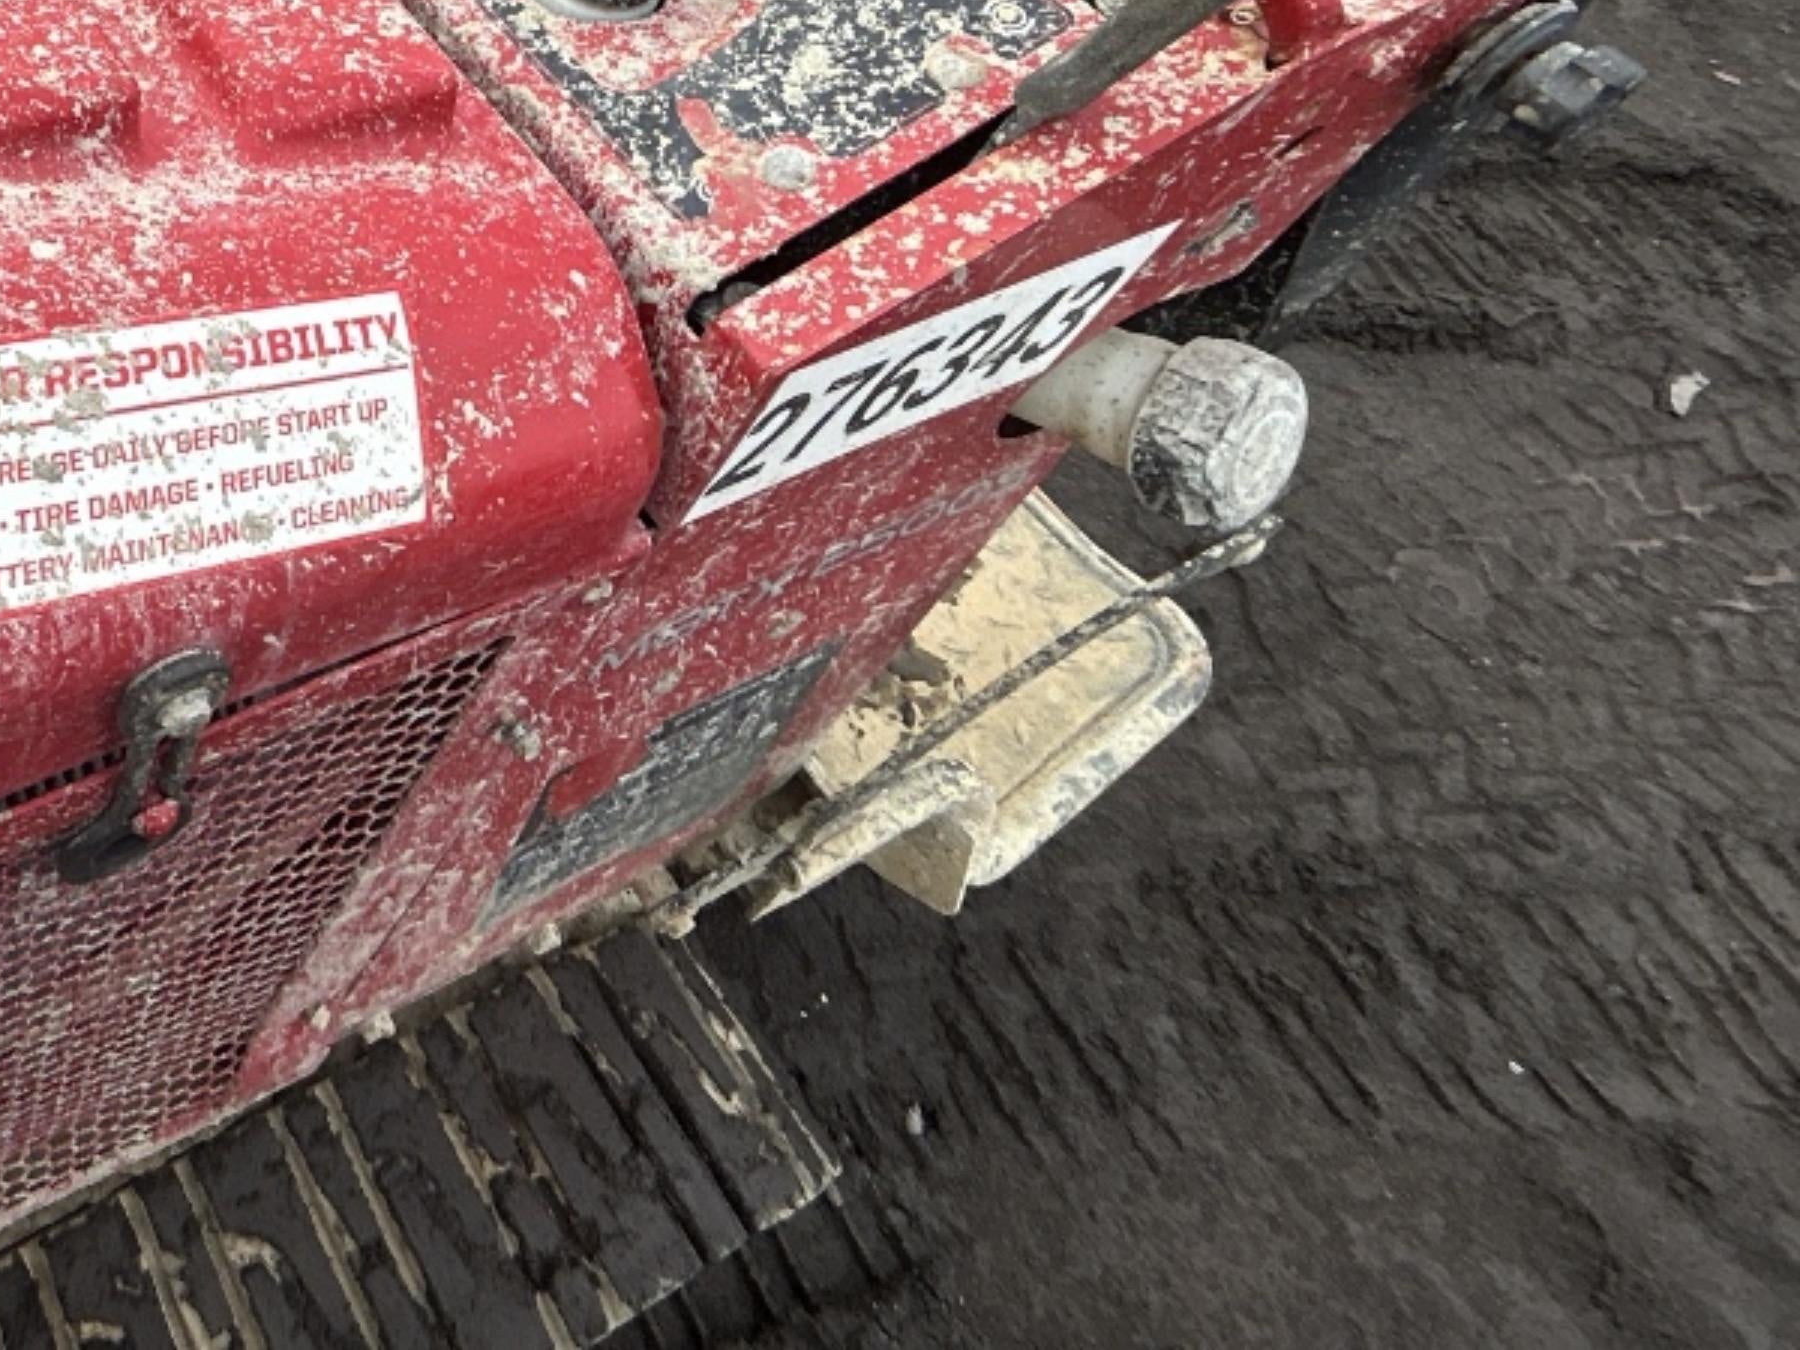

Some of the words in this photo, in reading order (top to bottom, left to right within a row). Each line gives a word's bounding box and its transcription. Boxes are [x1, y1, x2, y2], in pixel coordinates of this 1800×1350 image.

[705, 265, 1126, 497] 276343
[92, 433, 167, 469] DAILY
[176, 416, 271, 454] BEFORE
[277, 404, 351, 436] START
[357, 398, 388, 422] UP
[14, 500, 81, 534] TIRE
[89, 478, 198, 520] DAMAGE
[220, 452, 354, 496] REFUELING
[81, 512, 273, 573] MAINTENAN
[291, 485, 409, 529] CLEANING
